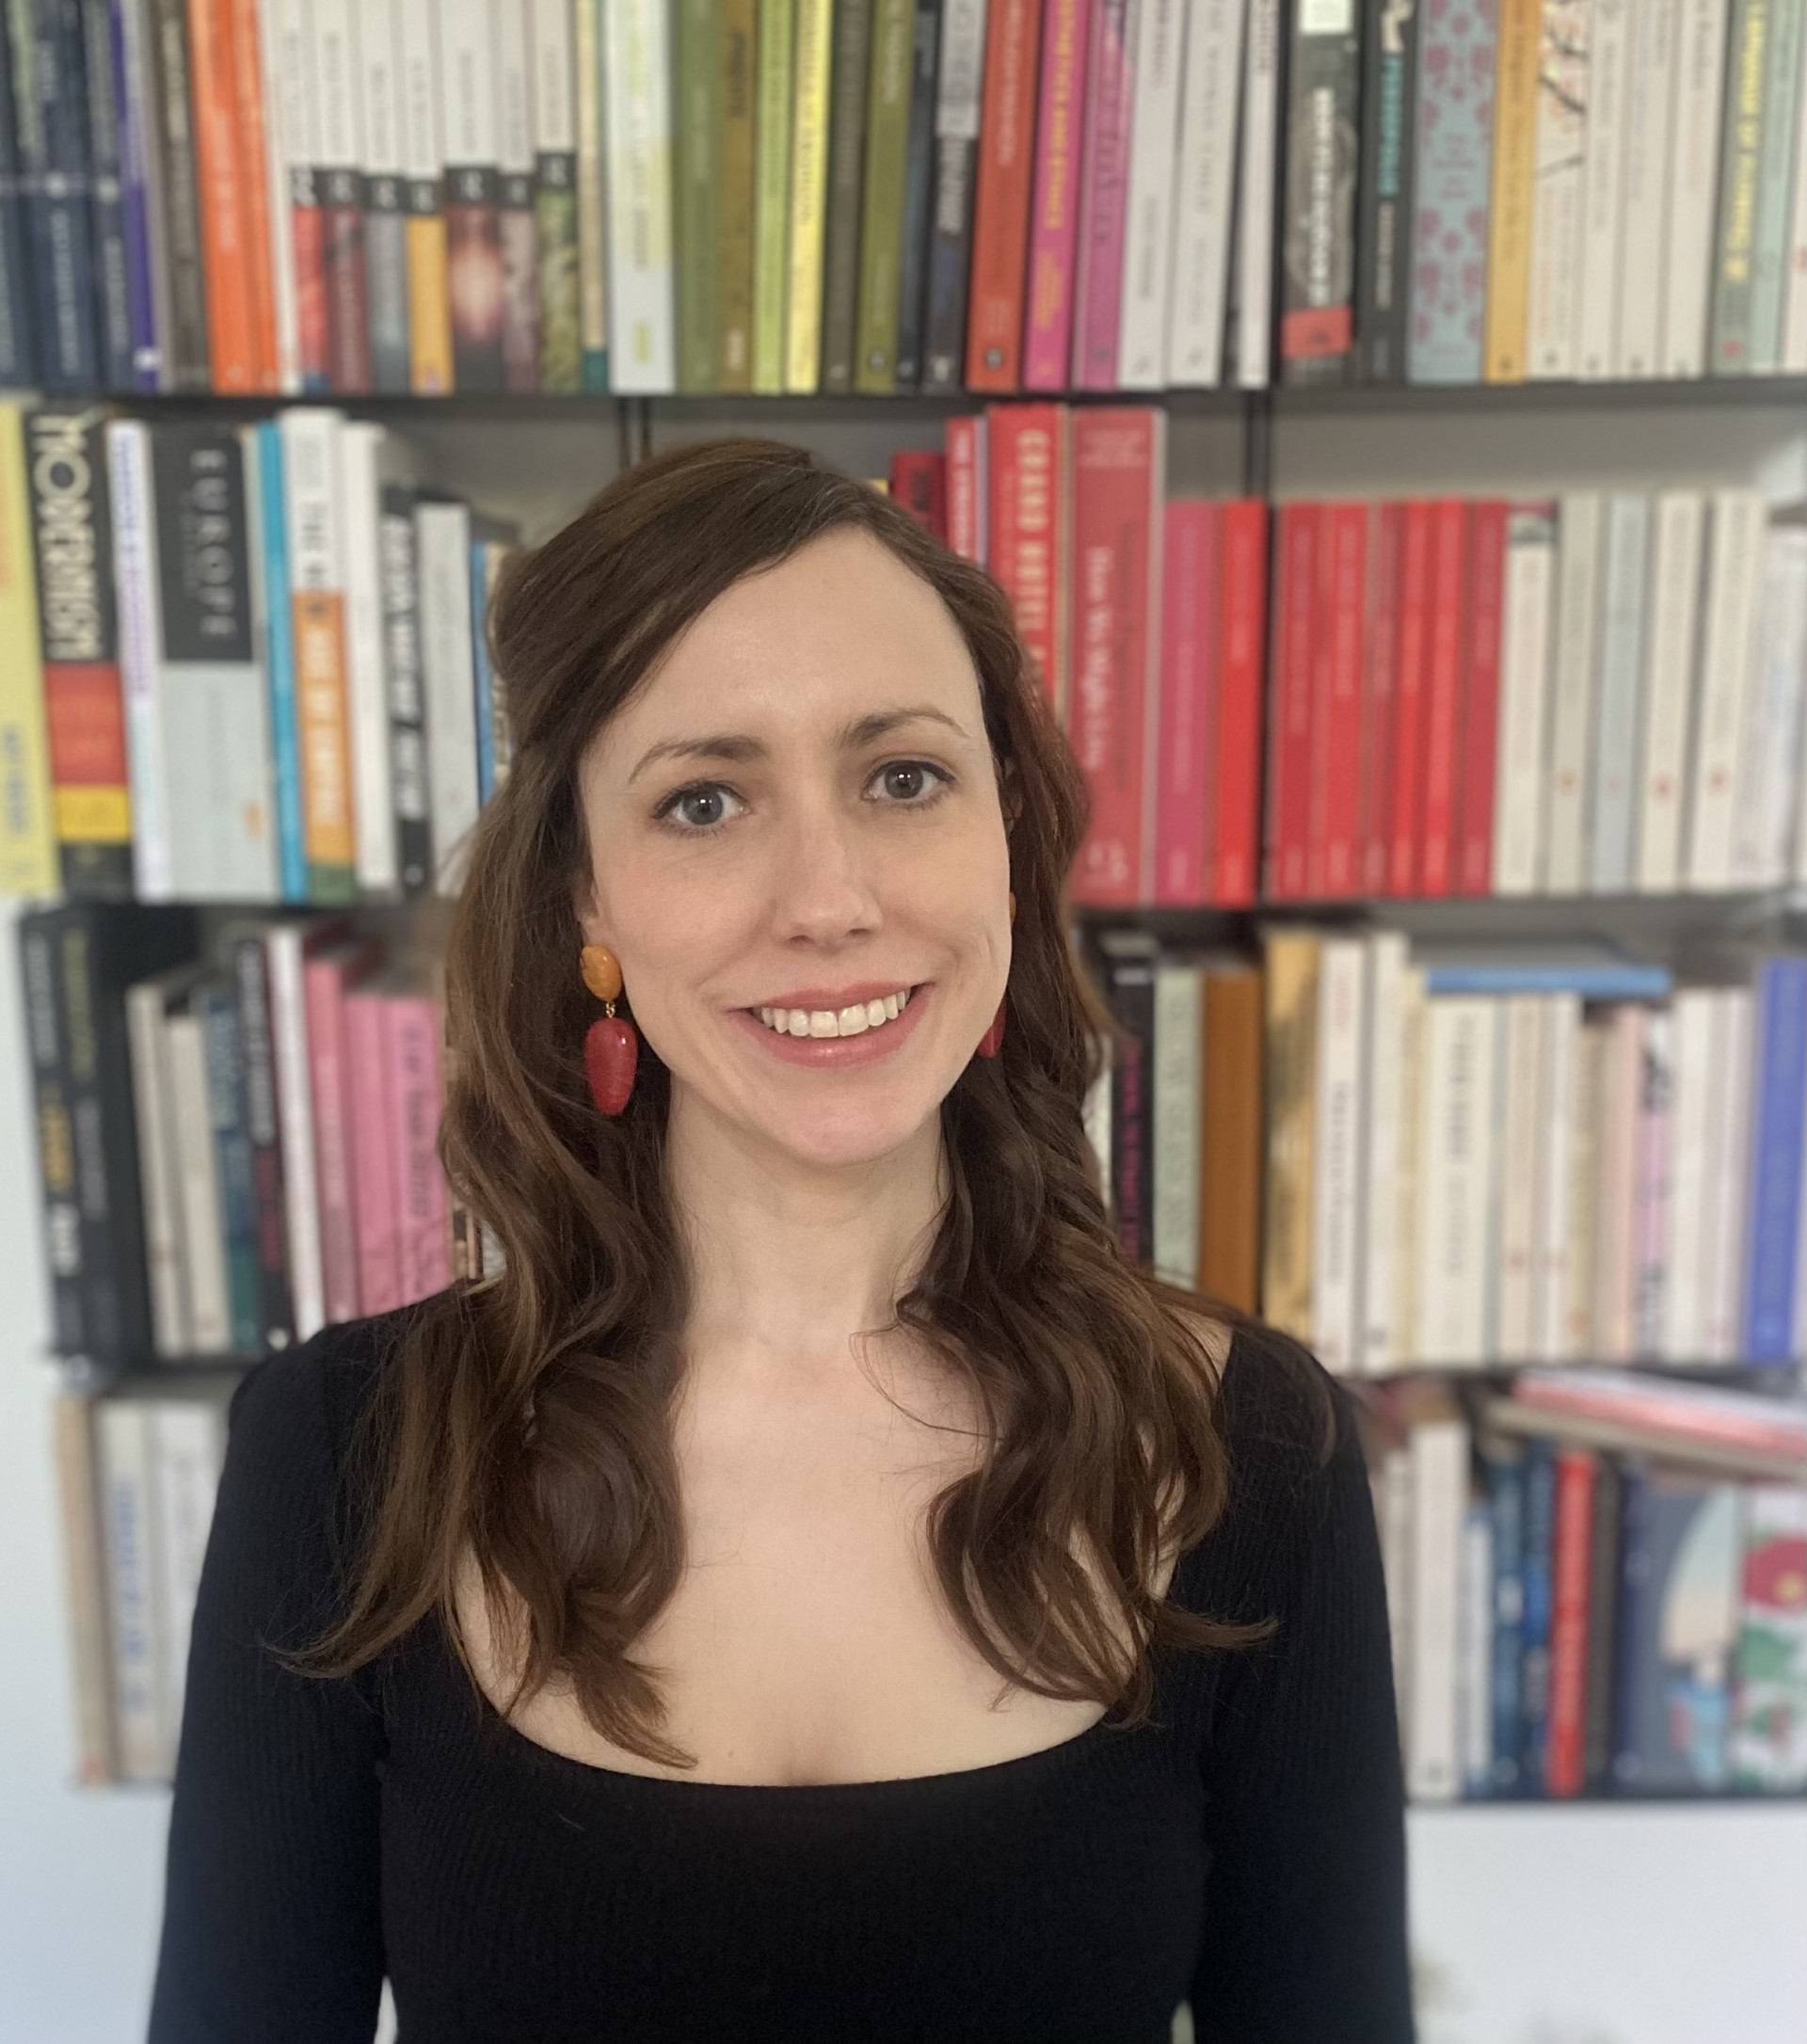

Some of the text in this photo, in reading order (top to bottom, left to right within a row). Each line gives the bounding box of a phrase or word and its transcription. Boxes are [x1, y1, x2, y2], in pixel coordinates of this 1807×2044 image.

[1378, 54, 1403, 196] PERSEPOLIS
[31, 407, 101, 660] MODERNISM
[190, 448, 237, 638] EUROPE
[1015, 428, 1050, 533] GRAND
[1015, 540, 1049, 631] HOTEL
